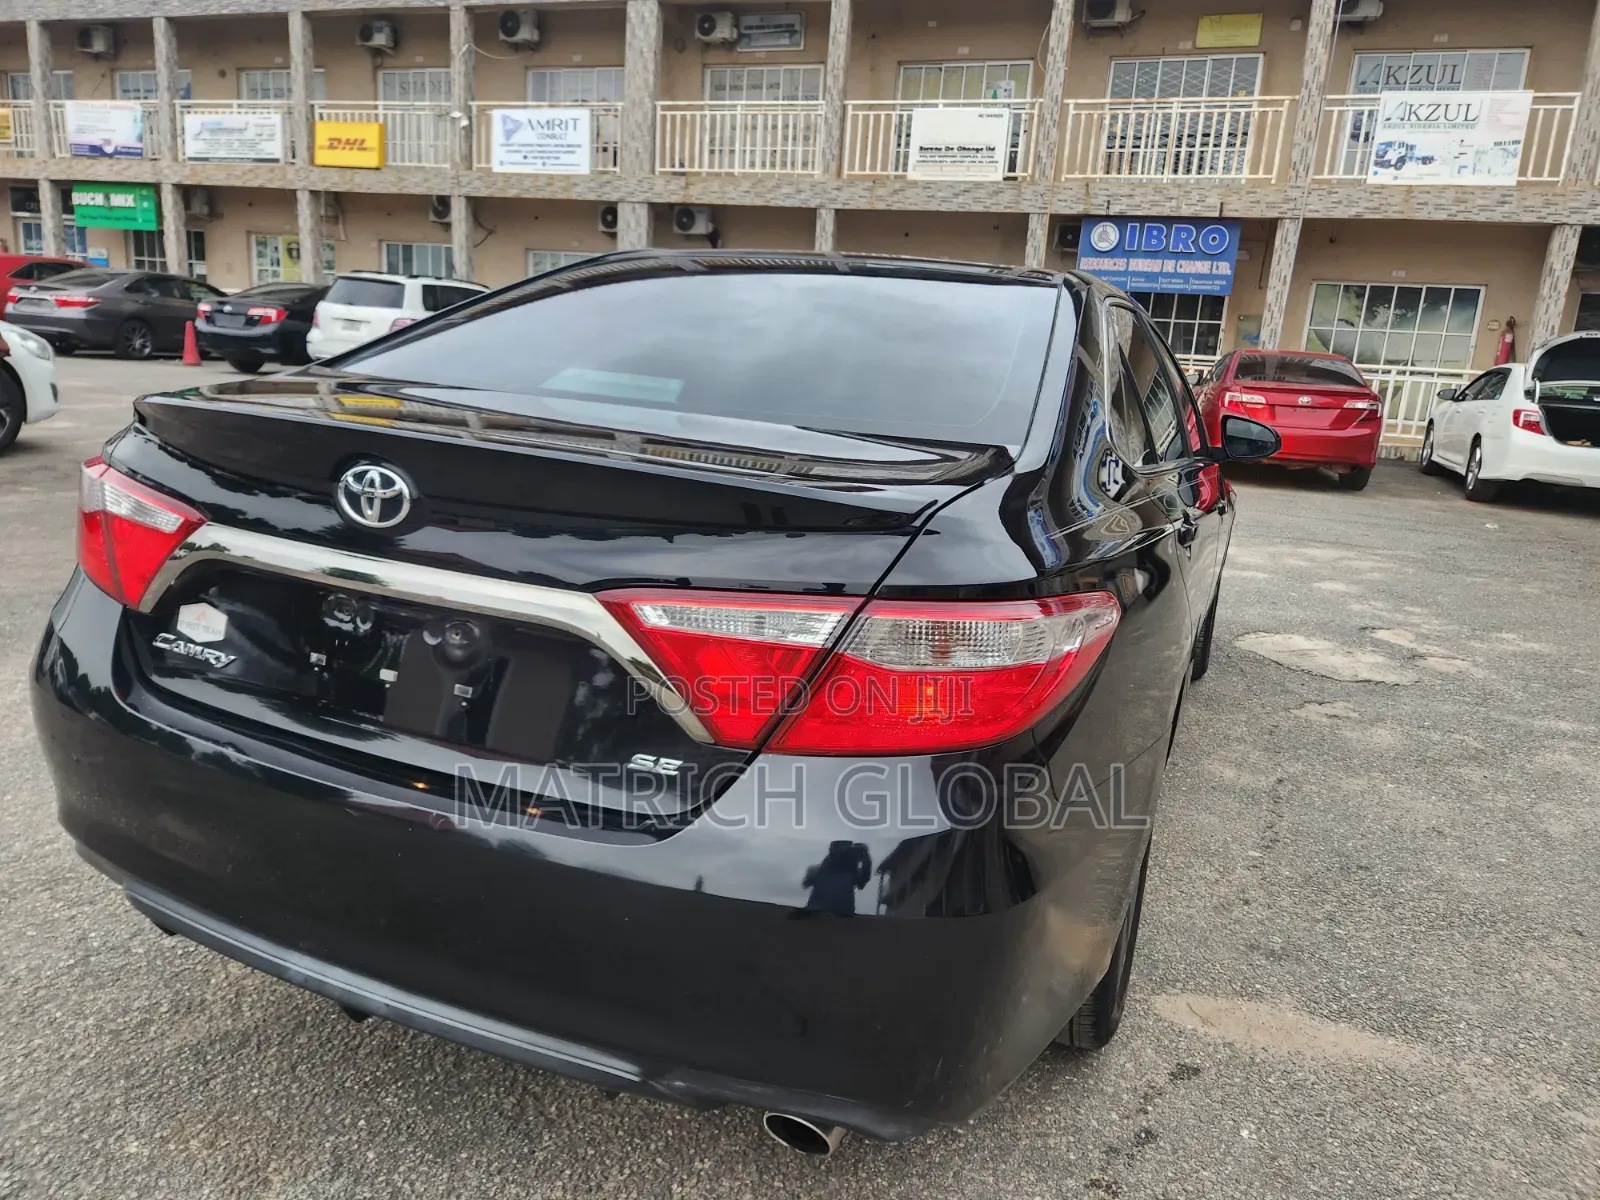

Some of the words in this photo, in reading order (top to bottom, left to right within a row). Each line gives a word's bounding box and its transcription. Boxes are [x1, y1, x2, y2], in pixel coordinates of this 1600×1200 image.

[1358, 63, 1463, 86] AKZUL
[1384, 101, 1479, 122] AKZUL
[527, 117, 581, 132] AMRIT
[327, 137, 368, 151] DHL
[1124, 222, 1230, 255] IBRO
[1079, 257, 1128, 271] RESOURCES
[1128, 258, 1163, 273] BUREAU
[1162, 259, 1176, 273] DE
[1176, 260, 1211, 275] CHANGE
[152, 633, 238, 669] CAMRY
[627, 753, 684, 776] SE
